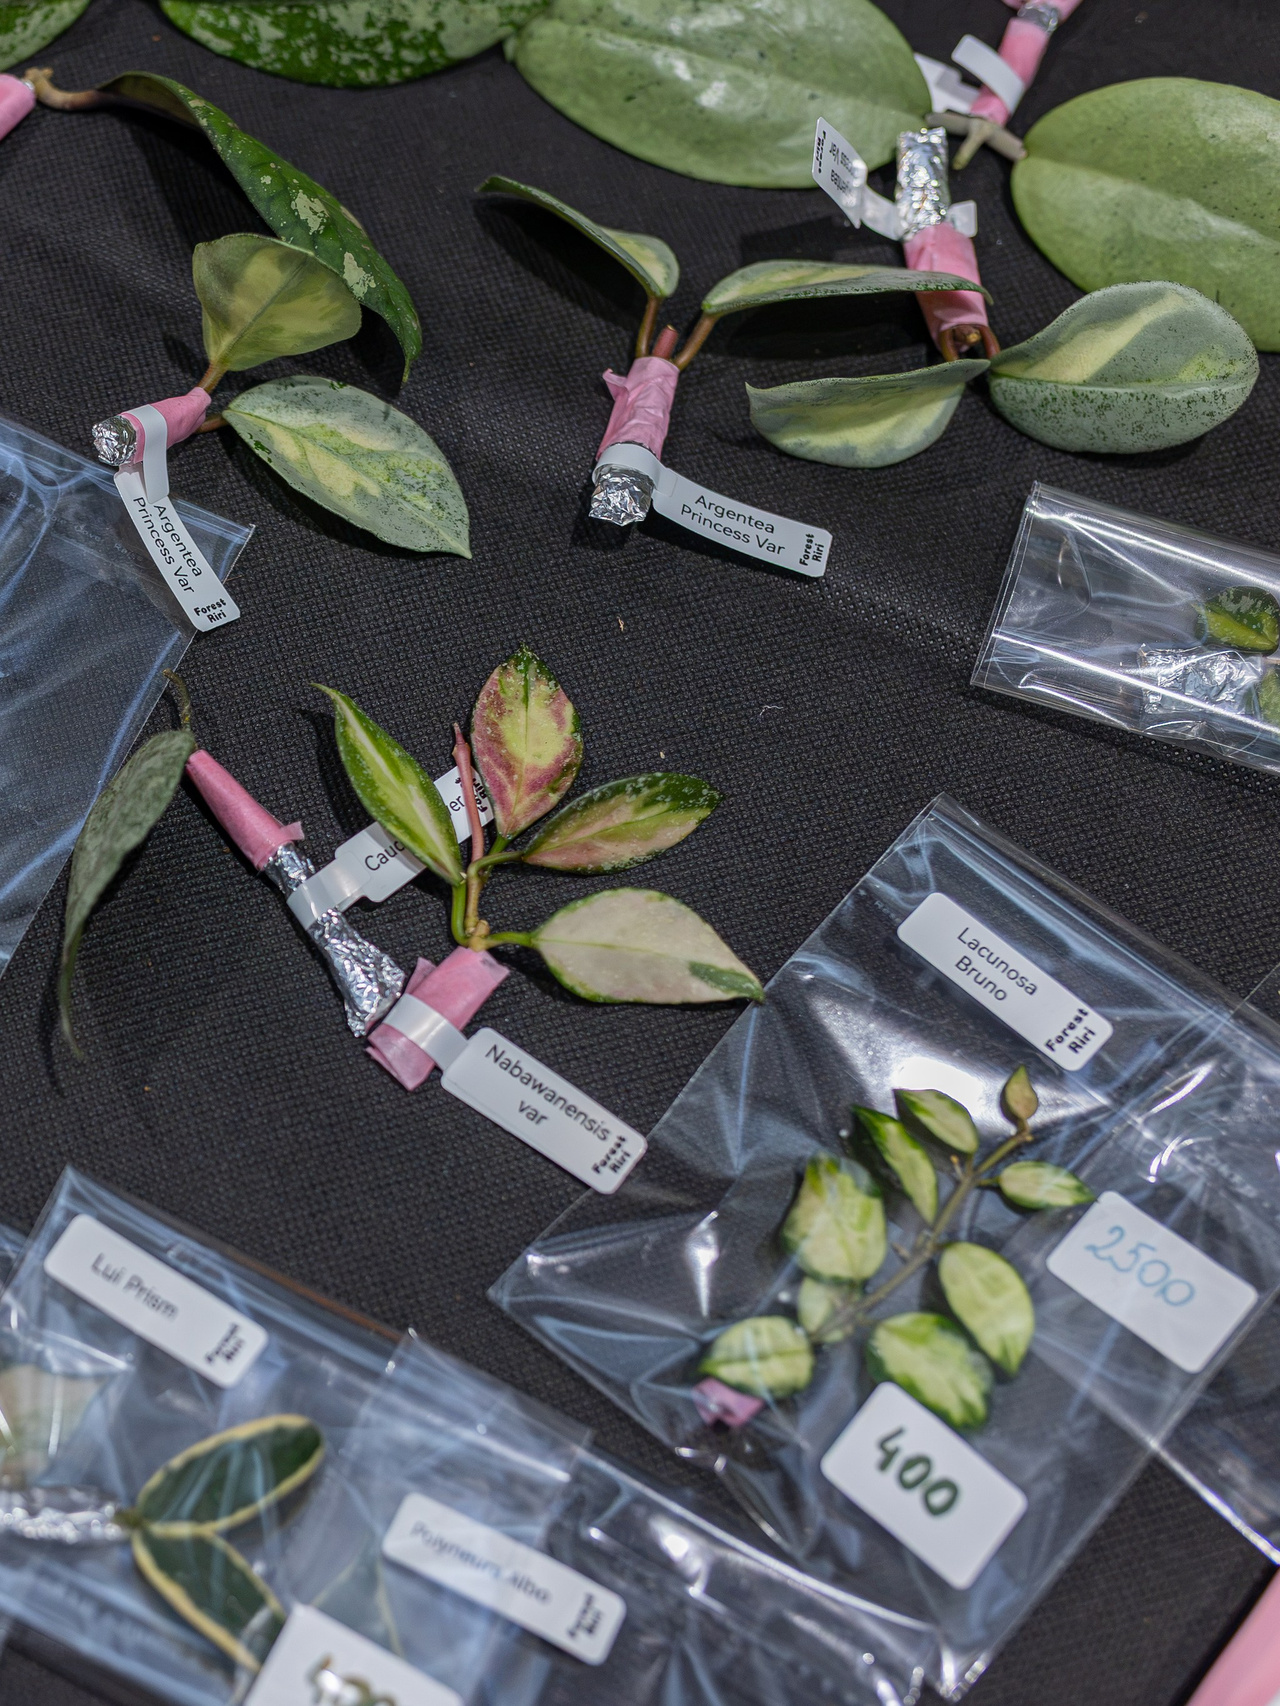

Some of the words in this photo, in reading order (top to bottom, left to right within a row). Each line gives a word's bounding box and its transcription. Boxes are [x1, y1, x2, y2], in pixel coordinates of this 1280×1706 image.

[680, 503, 751, 544] Princess
[755, 534, 786, 556] Var
[694, 495, 775, 535] Argentea
[133, 496, 175, 566] Princess
[174, 565, 195, 594] Var
[153, 504, 202, 578] Argentea
[799, 532, 815, 566] Forest
[811, 542, 825, 563] Riri
[193, 598, 227, 617] Forest
[207, 609, 227, 624] Riri
[954, 954, 1008, 1001] Bruno
[956, 926, 1039, 996] Lacunosa
[1043, 1007, 1090, 1052] Forest
[1067, 1026, 1097, 1054] Riri
[485, 1044, 612, 1142] Nabawanensis
[518, 1100, 549, 1126] var
[592, 1135, 627, 1175] Forest
[608, 1150, 632, 1174] Riri
[90, 1251, 125, 1285] Lui
[123, 1273, 180, 1322] Prism
[1084, 1224, 1196, 1307] 2500
[876, 1425, 961, 1518] 400
